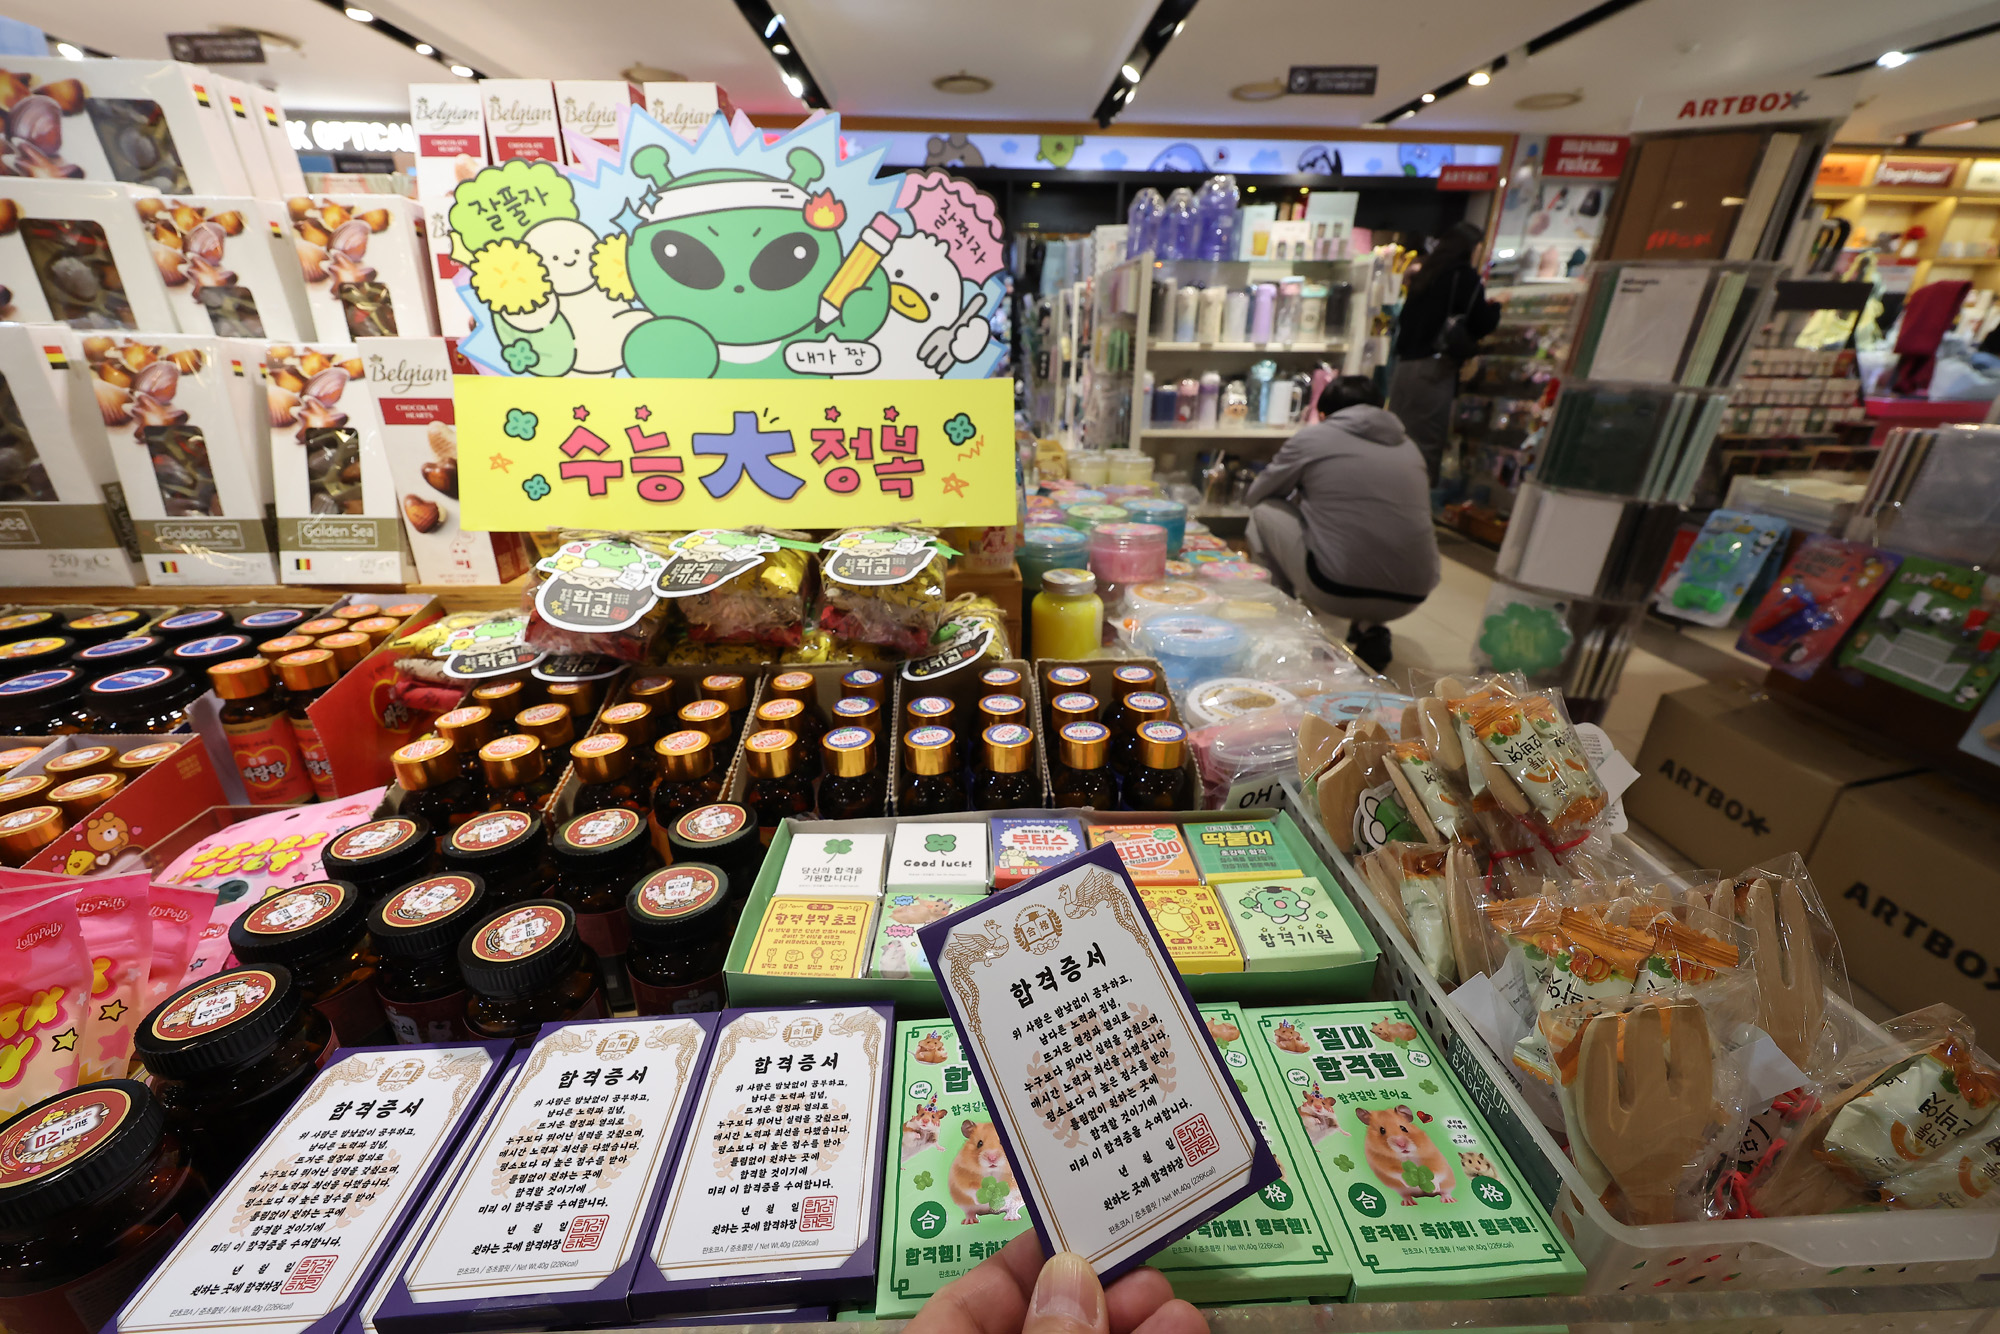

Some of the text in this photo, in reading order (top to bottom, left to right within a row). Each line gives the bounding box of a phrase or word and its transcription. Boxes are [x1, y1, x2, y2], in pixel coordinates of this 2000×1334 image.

[416, 102, 479, 131] Belgian
[489, 101, 552, 131] Belgian
[563, 102, 617, 134] Belgia
[468, 185, 549, 233] 잘풀자
[932, 199, 986, 266] 잘찍자
[796, 347, 867, 367] 내가 짱
[371, 359, 447, 394] Belgian
[162, 526, 239, 541] Golden Sea
[303, 524, 351, 540] Golden
[352, 524, 375, 538] Sea
[1504, 734, 1543, 765] 호박엿
[1526, 751, 1548, 771] 전통
[1658, 758, 1771, 837] ARTBOX
[1012, 833, 1069, 846] 부터스
[802, 867, 863, 875] 당신의 합격을
[904, 858, 973, 869] Good luck!
[775, 913, 857, 926] 합격 부적 초코
[16, 922, 64, 950] LollyPolly
[1259, 929, 1334, 948] 합격기원
[1009, 941, 1106, 1008] 합격증서
[1012, 974, 1132, 1040] 위 사람은 밤낮없이 공부하고,
[1038, 997, 1120, 1045] 남다른 노력과 집념,
[1042, 1010, 1131, 1063] 뜨거운 열정과 열의로
[1313, 1025, 1374, 1051] 절대
[754, 1052, 838, 1074] 합격증서
[1023, 1012, 1158, 1093] 누구보다 뛰어난 실력을 갖췄으며,
[558, 1065, 648, 1089] 합격증서
[1030, 1028, 1166, 1108] 매시간 노력과 최선을 다했습니다.
[1312, 1052, 1405, 1083] 합격햄
[1456, 1038, 1509, 1115] SENSE-UP
[1045, 1046, 1168, 1122] 평소보다 더 높은 점수를 받아
[1337, 1088, 1412, 1105] 합격길만 걸어요
[1452, 1053, 1494, 1115] BASKET
[328, 1097, 424, 1121] 합격증서
[1069, 1072, 1159, 1130] 틀림없이 원하는 곳에
[1089, 1094, 1157, 1141] 합격할 것이기에
[1068, 1097, 1192, 1171] 미리 이 합격증을 수여합니다.
[1914, 1122, 1948, 1149] 전통
[1117, 1136, 1175, 1177] 년 월 일
[1103, 1155, 1184, 1210] 원하는 곳에 합격하장
[1264, 1184, 1287, 1203] 格
[1356, 1183, 1503, 1210] 合 格
[917, 1210, 940, 1231] 合
[1255, 1218, 1313, 1236] 행복햄!
[1359, 1216, 1539, 1243] 합격햄! 축하햄! 행복햄!
[905, 1244, 962, 1267] 합격햄!
